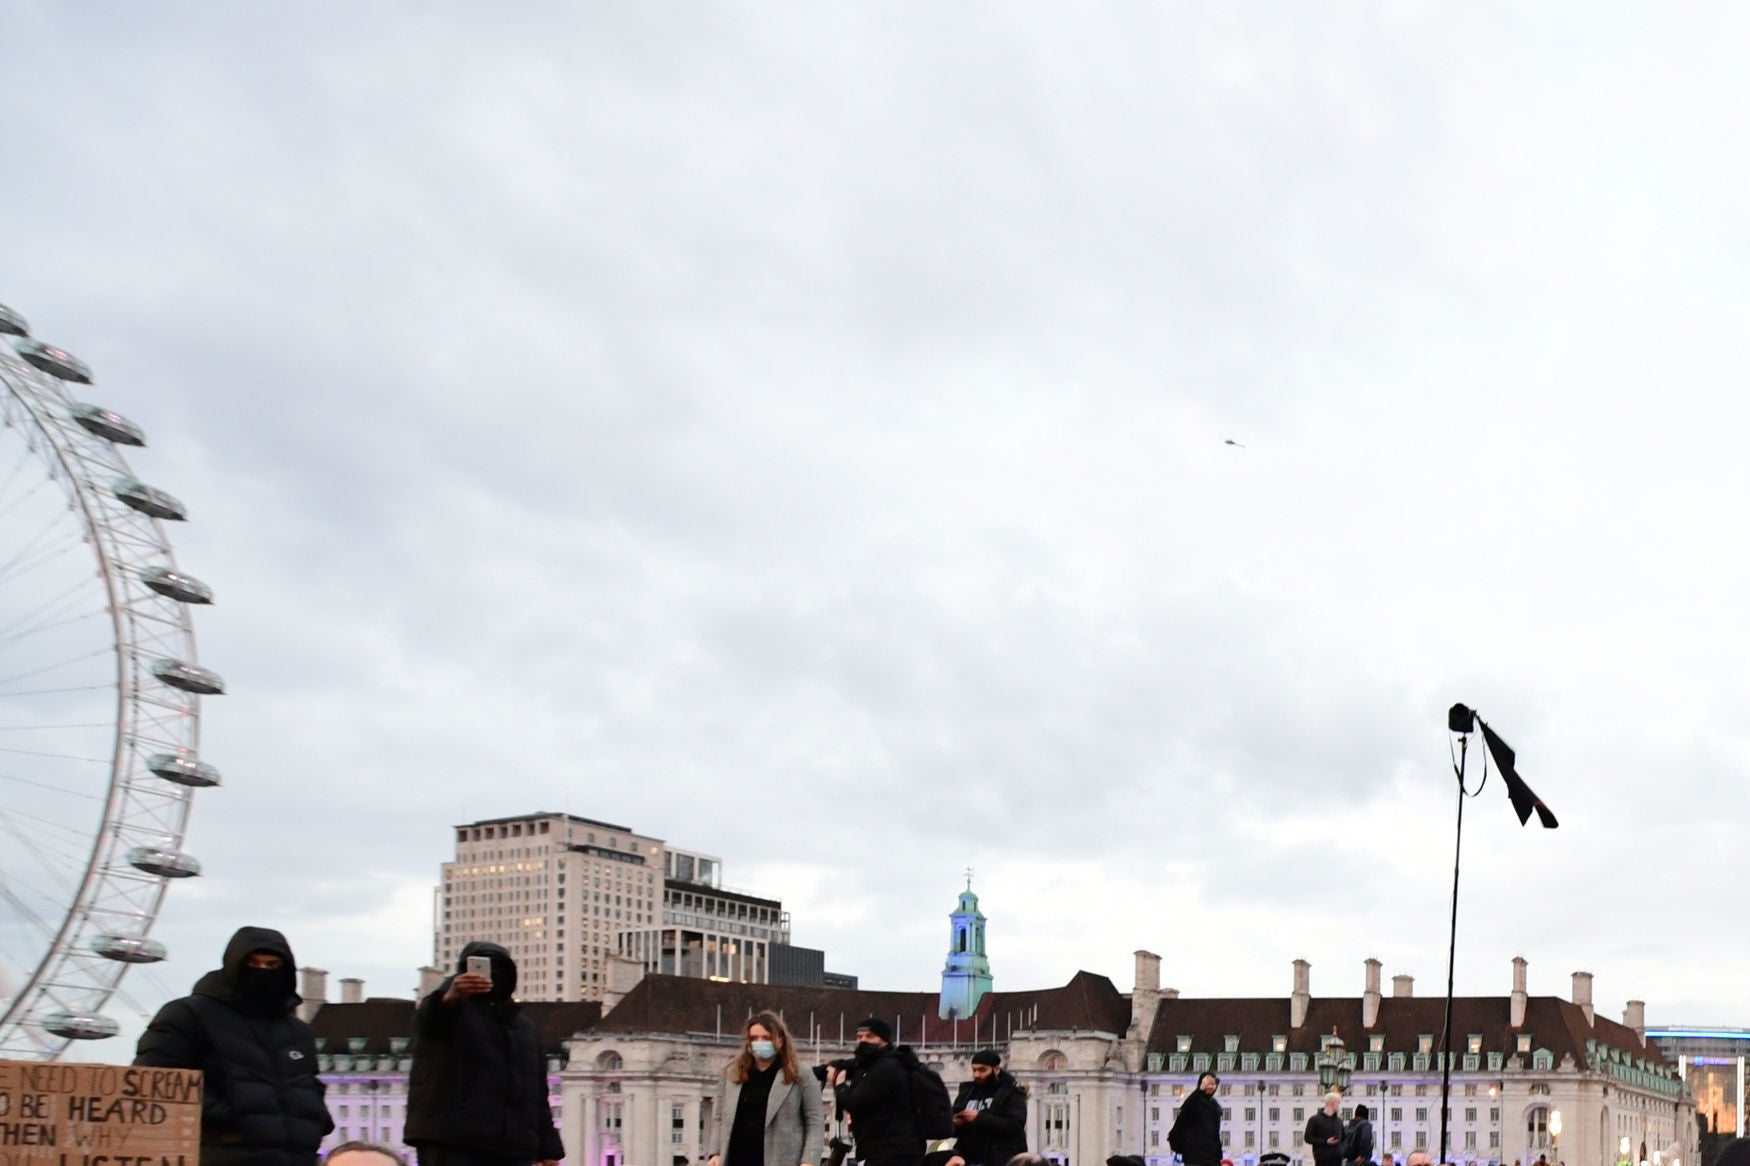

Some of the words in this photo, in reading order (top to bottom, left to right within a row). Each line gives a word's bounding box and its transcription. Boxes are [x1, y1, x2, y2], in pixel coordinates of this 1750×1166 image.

[20, 1064, 78, 1094] NEED
[84, 1066, 118, 1097] TO
[122, 1069, 202, 1101] SCREAM
[20, 1093, 49, 1119] BE
[68, 1096, 168, 1125] HEARD
[74, 1124, 133, 1150] WHY
